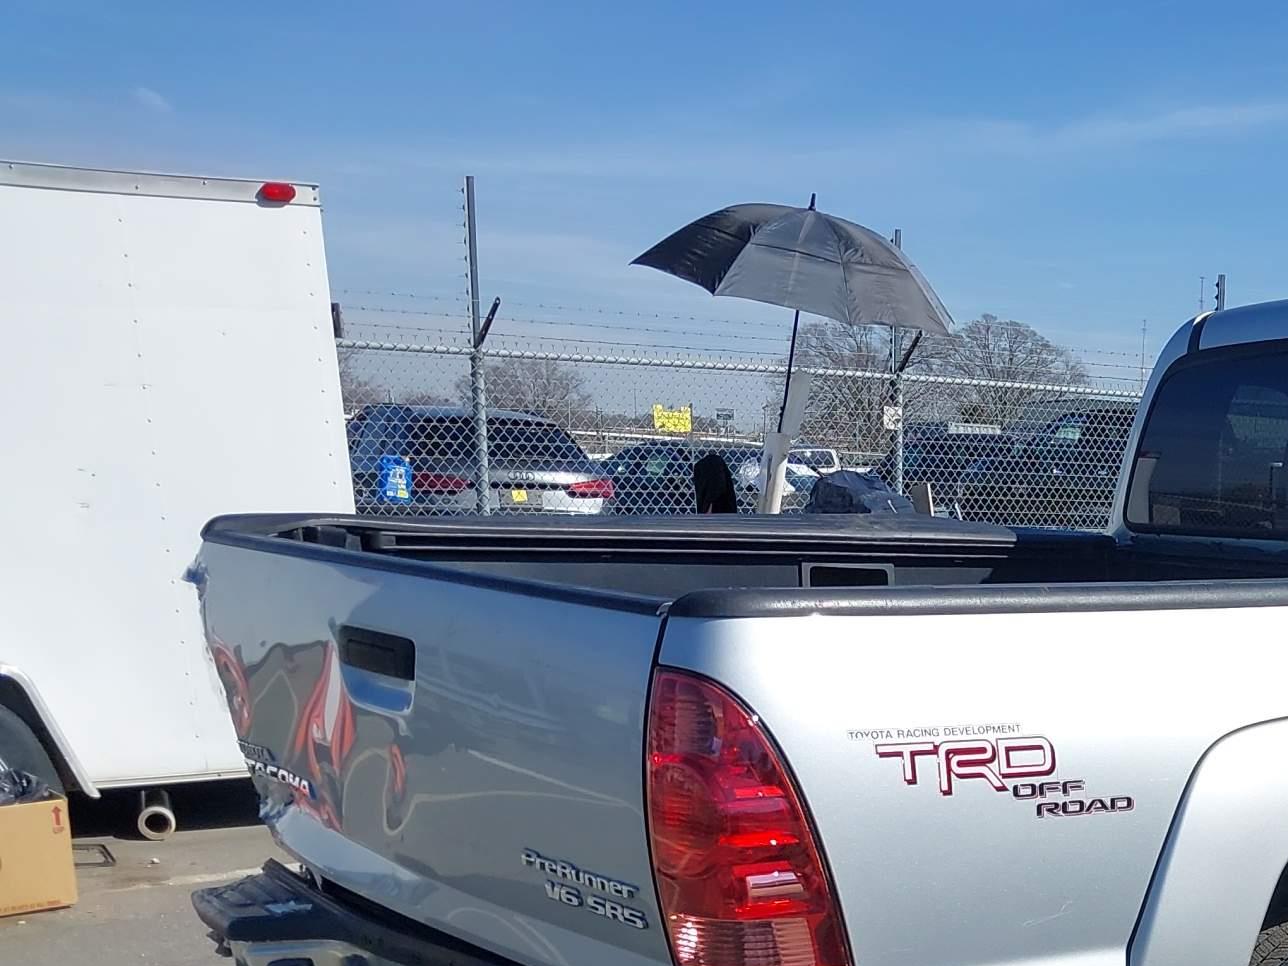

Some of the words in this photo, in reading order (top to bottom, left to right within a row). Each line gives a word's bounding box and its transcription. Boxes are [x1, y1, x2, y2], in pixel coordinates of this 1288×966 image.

[848, 730, 893, 740] TOYOTA
[896, 727, 940, 739] RACING
[943, 724, 1022, 737] DEVELOPMENT
[875, 736, 1057, 796] TRD
[1012, 780, 1086, 800] OFF
[1036, 796, 1135, 818] ROAD
[520, 848, 640, 899] PreRunner
[544, 880, 583, 907] V6
[585, 896, 649, 930] SR5
